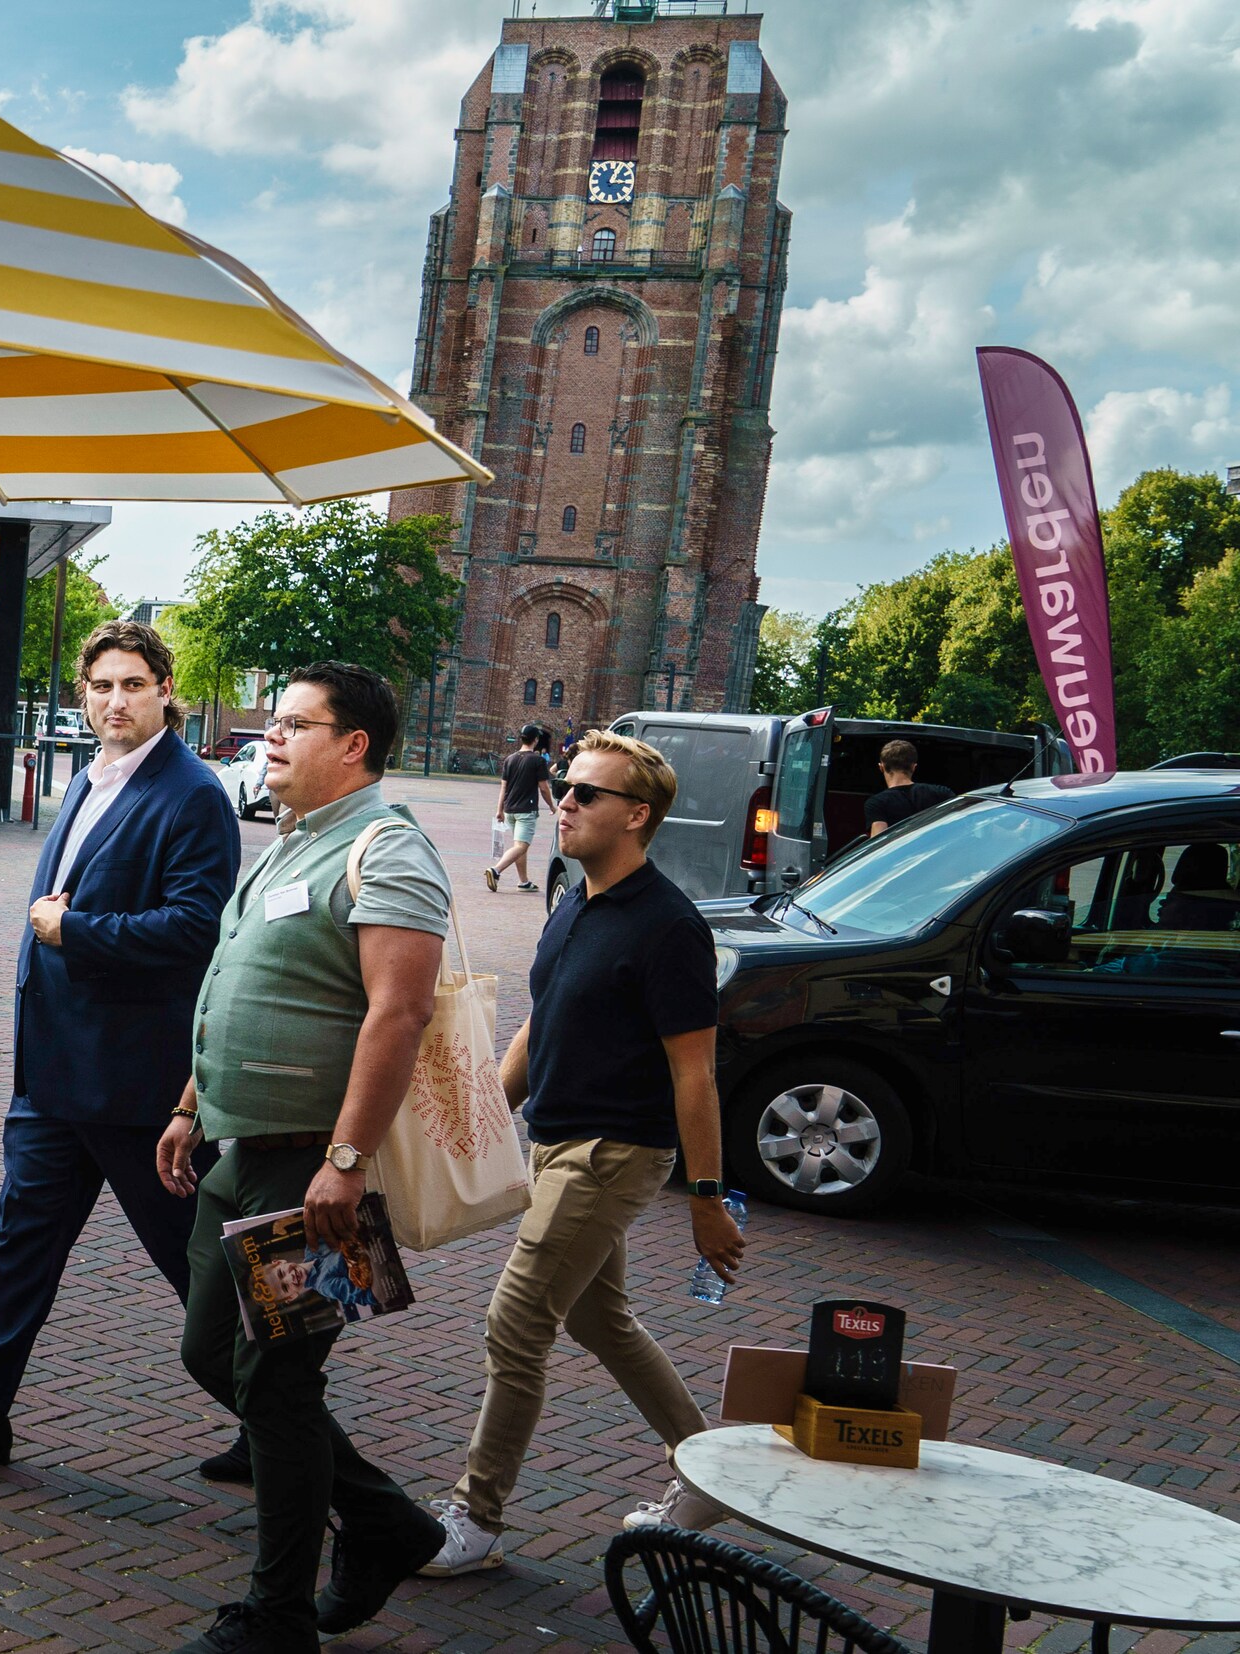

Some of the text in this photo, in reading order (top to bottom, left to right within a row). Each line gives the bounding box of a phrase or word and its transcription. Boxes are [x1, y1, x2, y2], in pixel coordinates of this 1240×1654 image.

[441, 1046, 450, 1066] oars
[432, 1059, 452, 1075] bern
[432, 1073, 458, 1086] hjoed
[413, 1084, 428, 1099] lyts
[448, 1083, 459, 1116] skoalle
[411, 1097, 432, 1114] sinne
[837, 1313, 880, 1332] TEXELS
[833, 1419, 904, 1447] TEXELS
